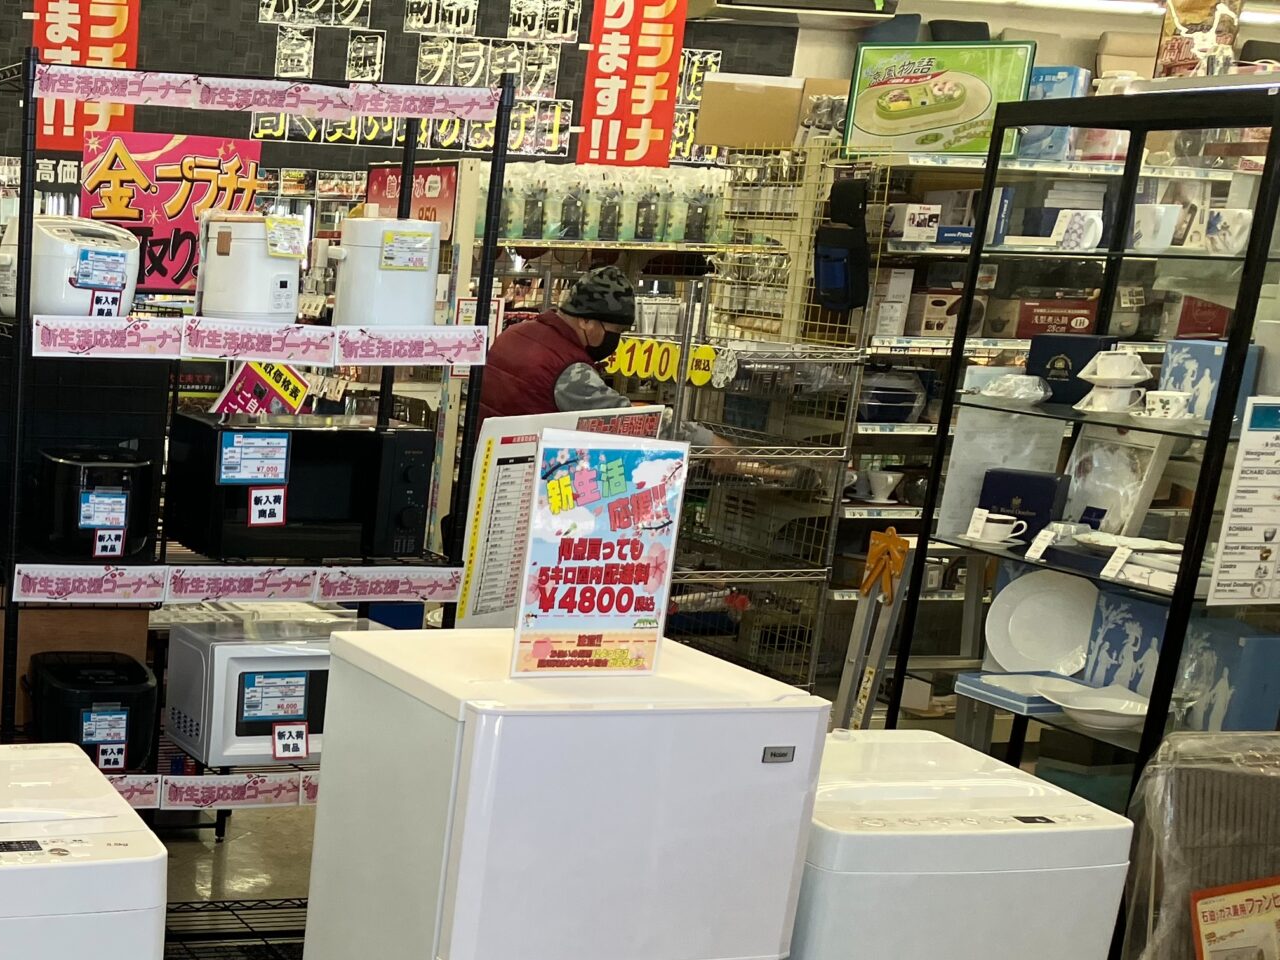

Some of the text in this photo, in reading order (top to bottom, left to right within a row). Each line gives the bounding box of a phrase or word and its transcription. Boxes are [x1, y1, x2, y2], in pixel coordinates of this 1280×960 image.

[35, 159, 84, 186] 高価
[95, 296, 118, 305] 新入荷
[40, 329, 181, 349] 新生活応援コーナー
[188, 329, 330, 354] 新生活応援コーナー
[342, 340, 481, 359] 新生活応援コーナー
[261, 362, 301, 401] 取価格表
[546, 458, 627, 515] 新生活
[254, 495, 282, 506] 新入荷
[258, 508, 277, 519] 商品
[98, 534, 122, 542] 新入荷
[558, 537, 645, 565] 何点買っても
[21, 577, 163, 595] 新生活応援コーナー
[172, 577, 312, 596] 新生活応援コーナー
[322, 579, 457, 597] 新生活応援コーナー
[278, 731, 304, 740] 新入荷
[282, 743, 300, 752] 商品
[168, 785, 300, 803] 新生活応援コーナー
